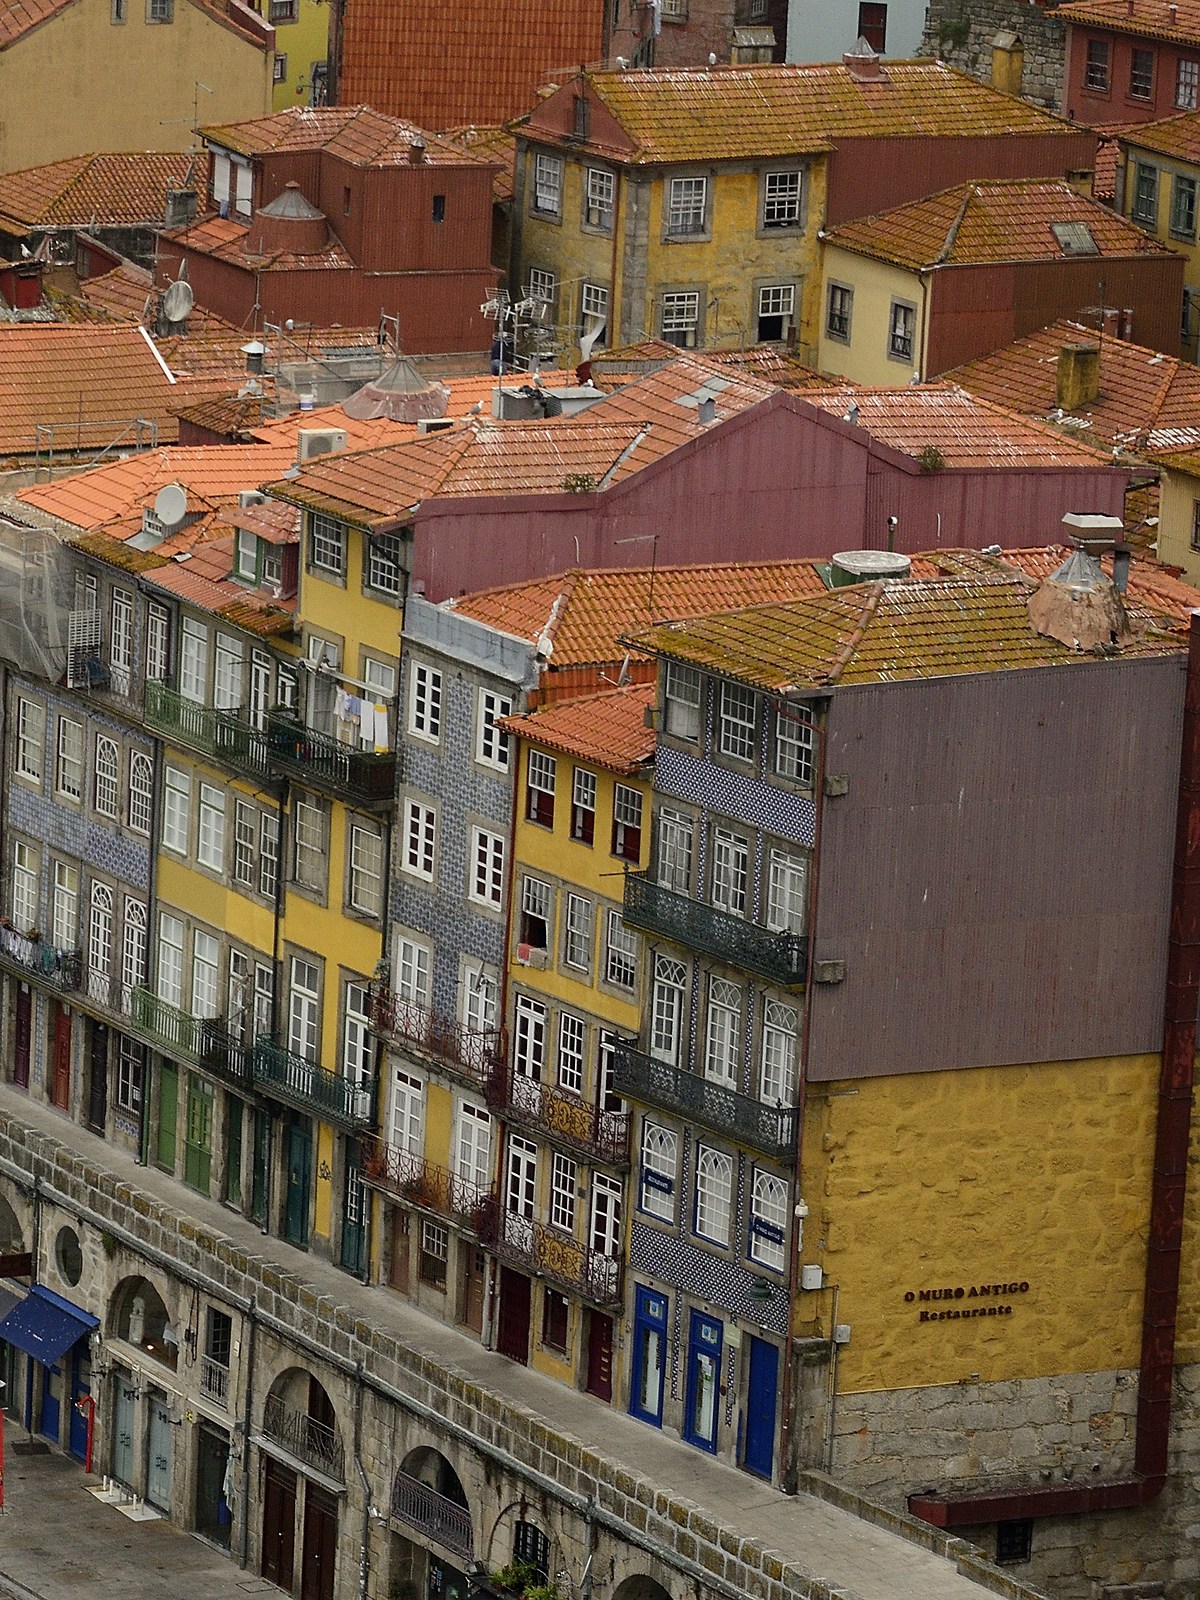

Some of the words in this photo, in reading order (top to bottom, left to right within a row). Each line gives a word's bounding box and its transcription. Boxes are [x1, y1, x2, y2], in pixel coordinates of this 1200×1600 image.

[904, 1291, 915, 1302] O
[918, 1287, 965, 1302] MURO
[967, 1281, 1030, 1298] ANTIGO
[919, 1304, 1013, 1322] Restaurante
